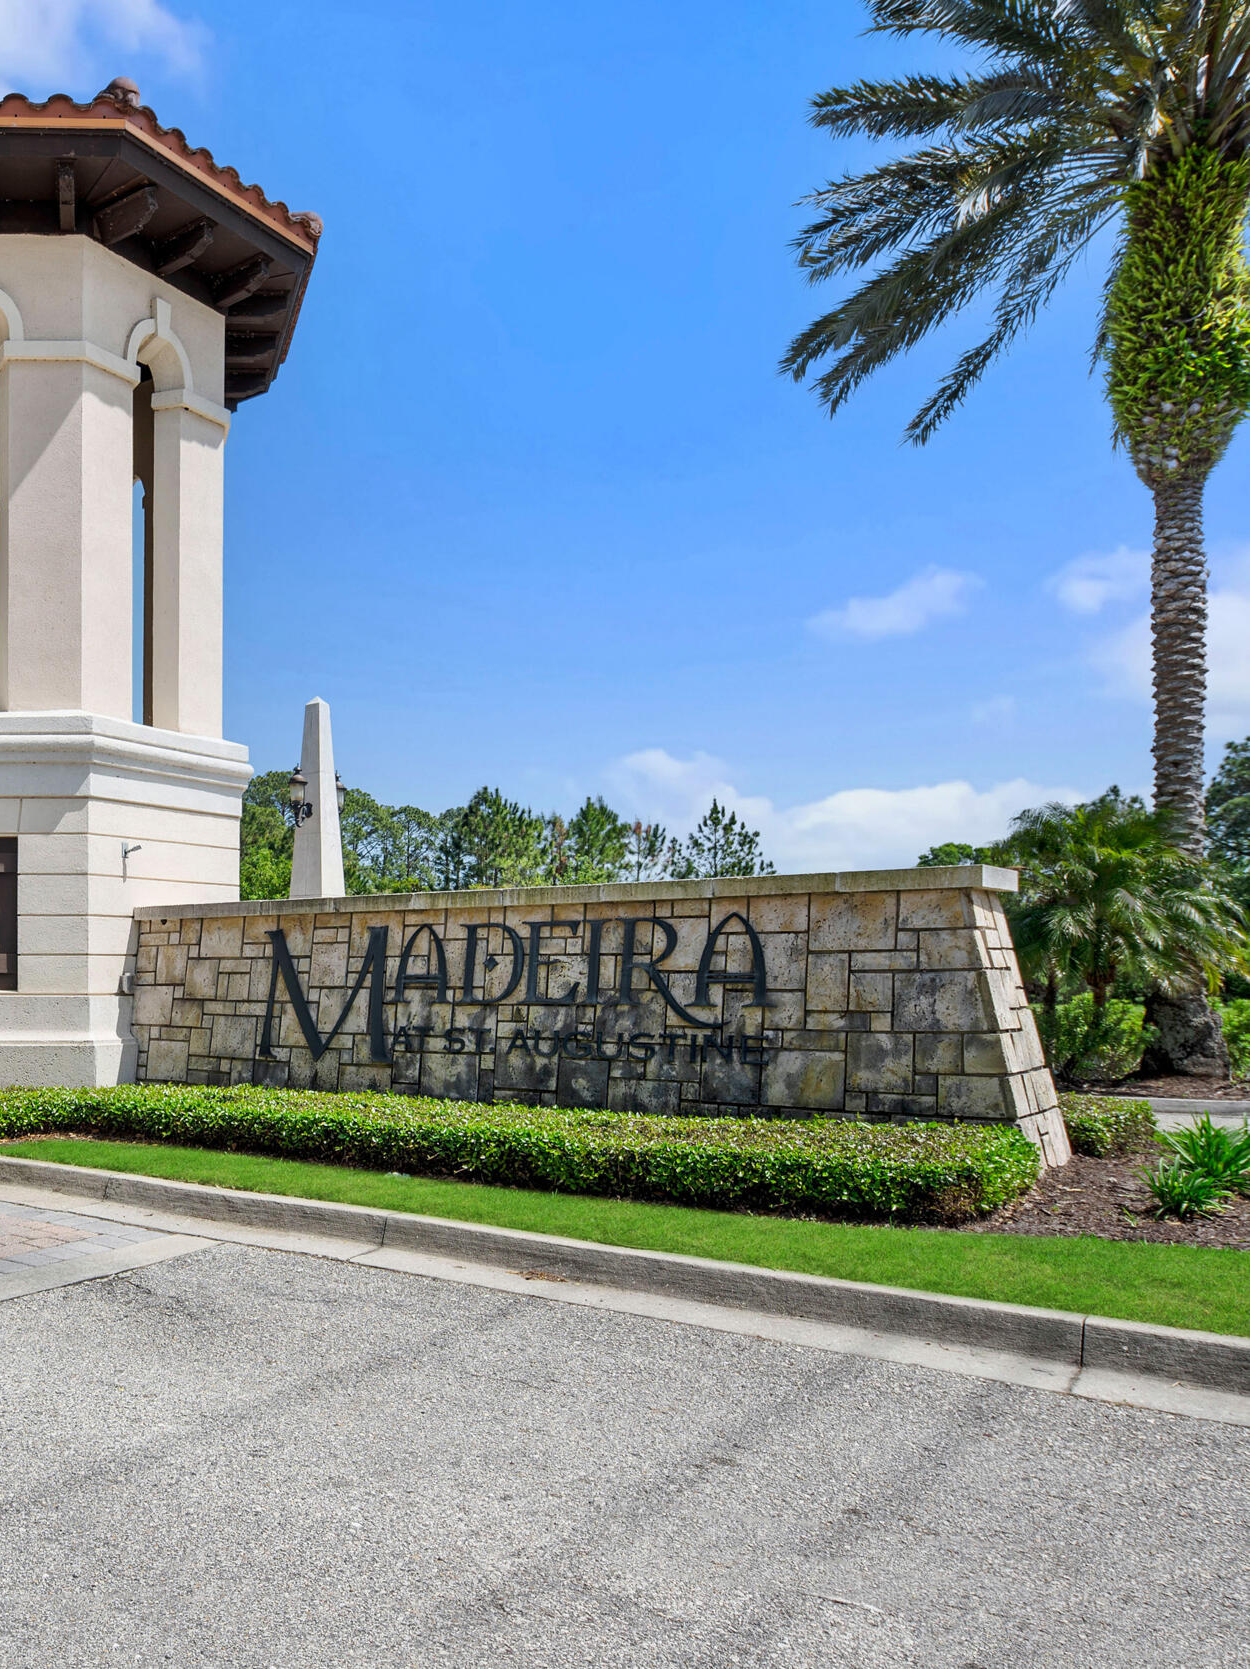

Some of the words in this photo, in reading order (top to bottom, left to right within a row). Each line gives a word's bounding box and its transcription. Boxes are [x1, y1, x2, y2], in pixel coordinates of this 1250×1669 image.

[257, 911, 777, 1063] MADEIRA
[391, 1025, 435, 1052] AT
[442, 1026, 496, 1054] ST.
[505, 1028, 770, 1066] AUGUSTINE
